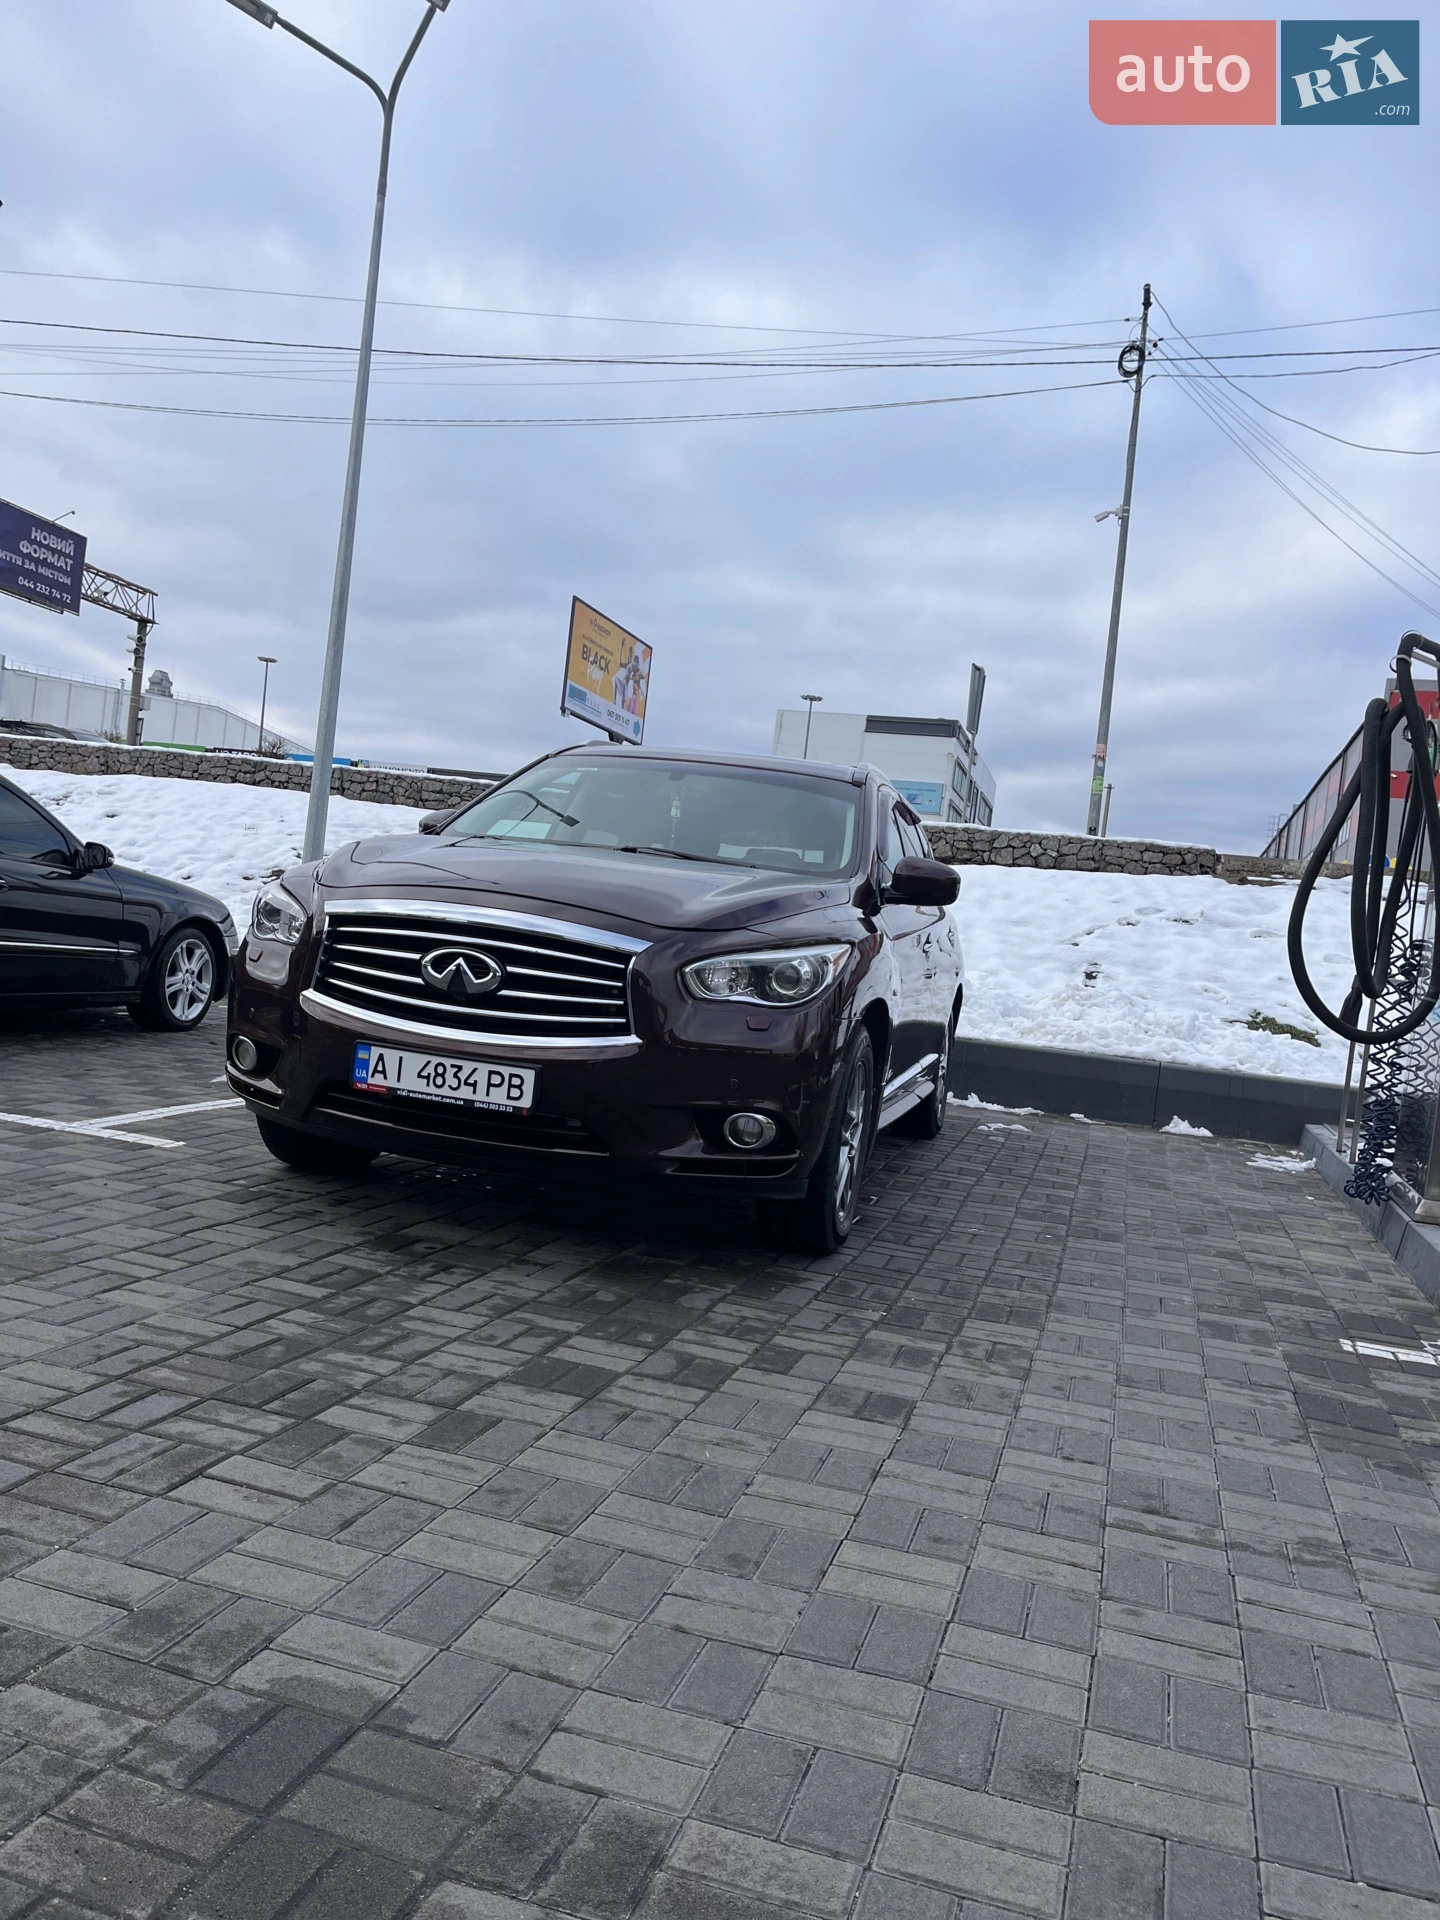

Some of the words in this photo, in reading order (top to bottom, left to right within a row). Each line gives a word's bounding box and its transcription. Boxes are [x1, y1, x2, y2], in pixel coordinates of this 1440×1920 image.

[31, 527, 75, 556] НОВИЙ
[19, 540, 74, 572] ФОРМАТ
[23, 559, 36, 572] ЗА
[38, 564, 71, 586] МІСТОМ
[18, 576, 35, 589] 044
[36, 582, 50, 596] 232
[51, 588, 61, 599] 74
[62, 593, 71, 604] 72
[581, 643, 611, 675] BLACK
[355, 1068, 367, 1079] UA
[370, 1052, 403, 1083] AI
[417, 1060, 479, 1095] 4834
[485, 1069, 525, 1101] PB
[396, 1089, 464, 1105] vidi-automarket.com.ua
